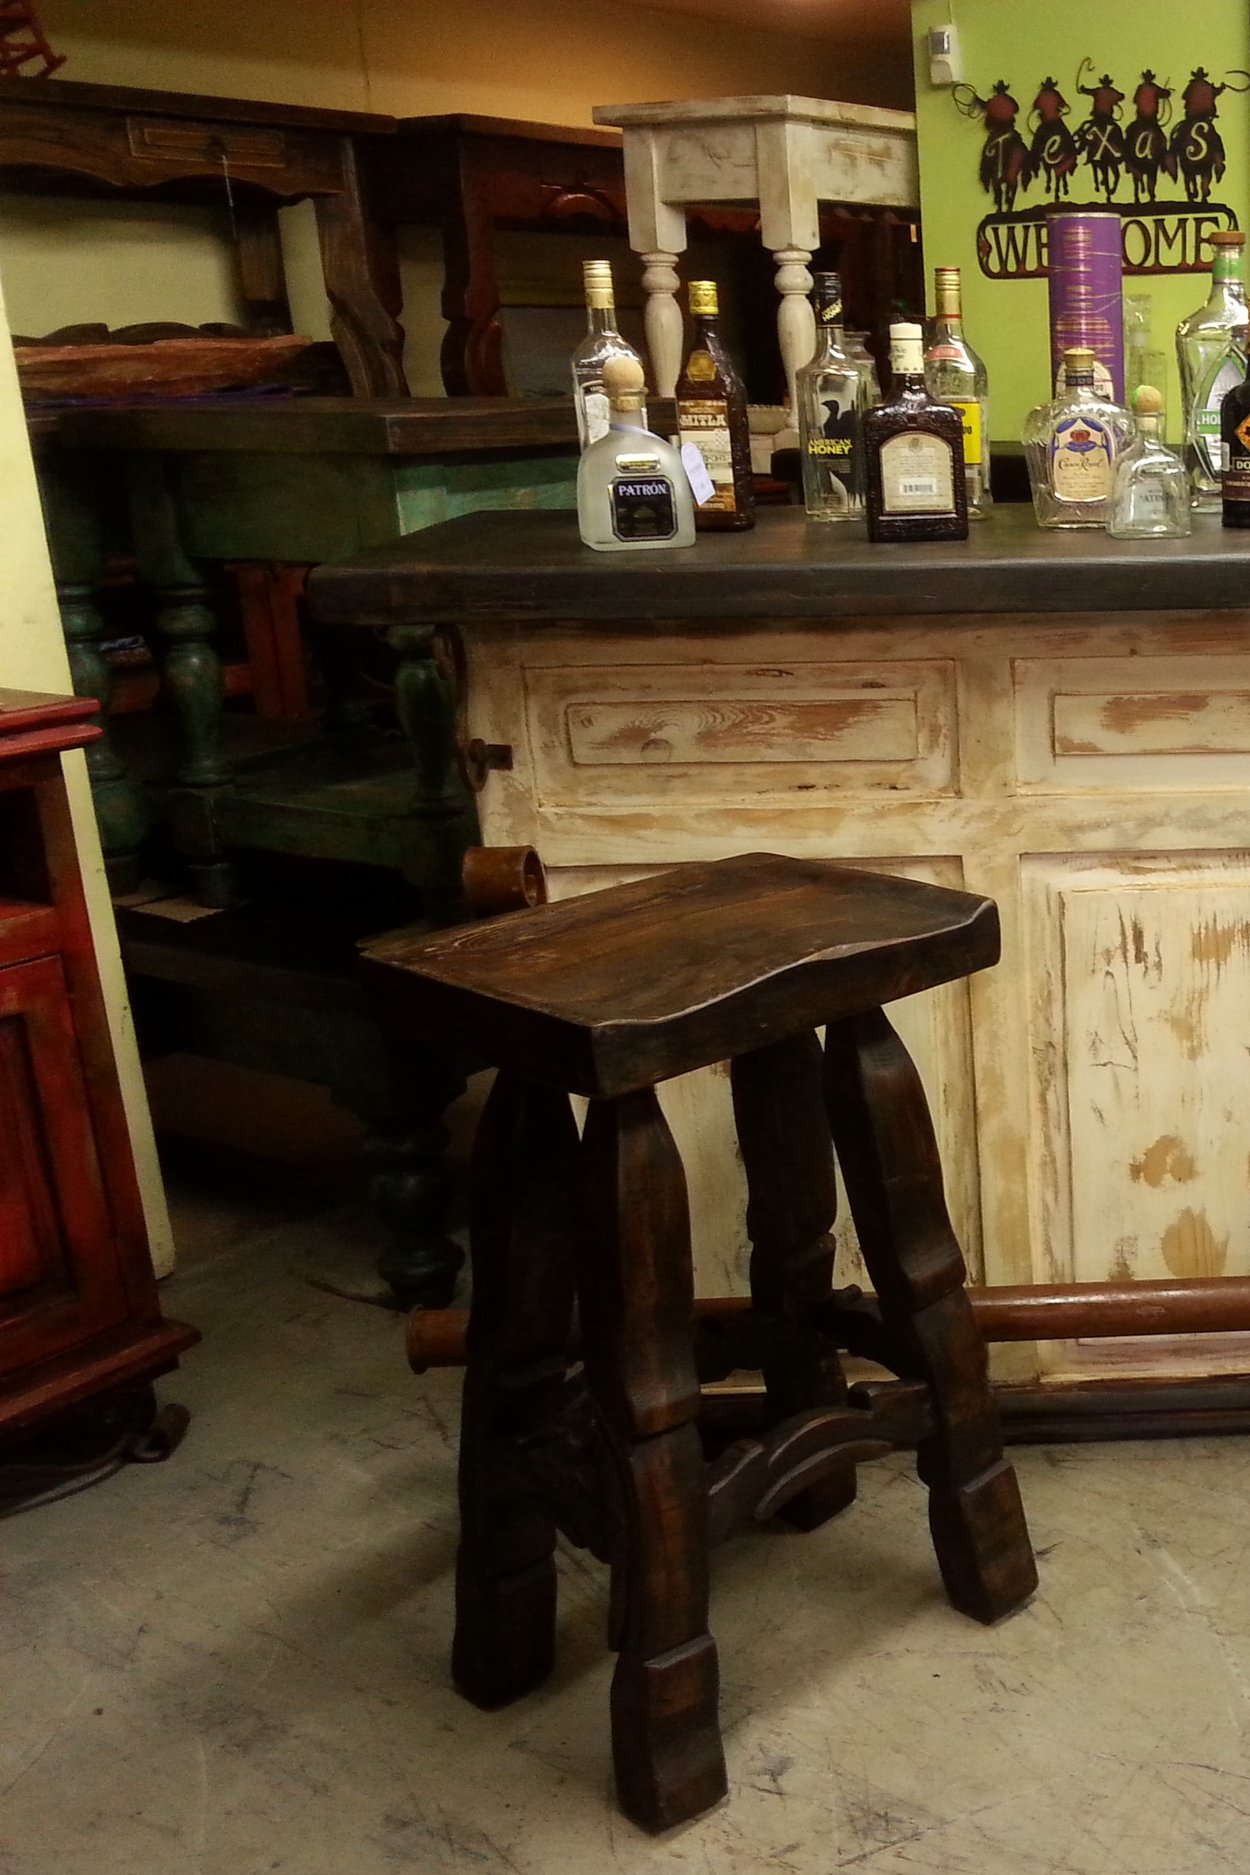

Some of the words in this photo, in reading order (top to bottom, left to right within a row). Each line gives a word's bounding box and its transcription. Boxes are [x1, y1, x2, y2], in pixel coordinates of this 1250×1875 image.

[991, 216, 1221, 272] WEOME
[808, 444, 852, 455] HONEY
[618, 481, 668, 497] PATRÓN
